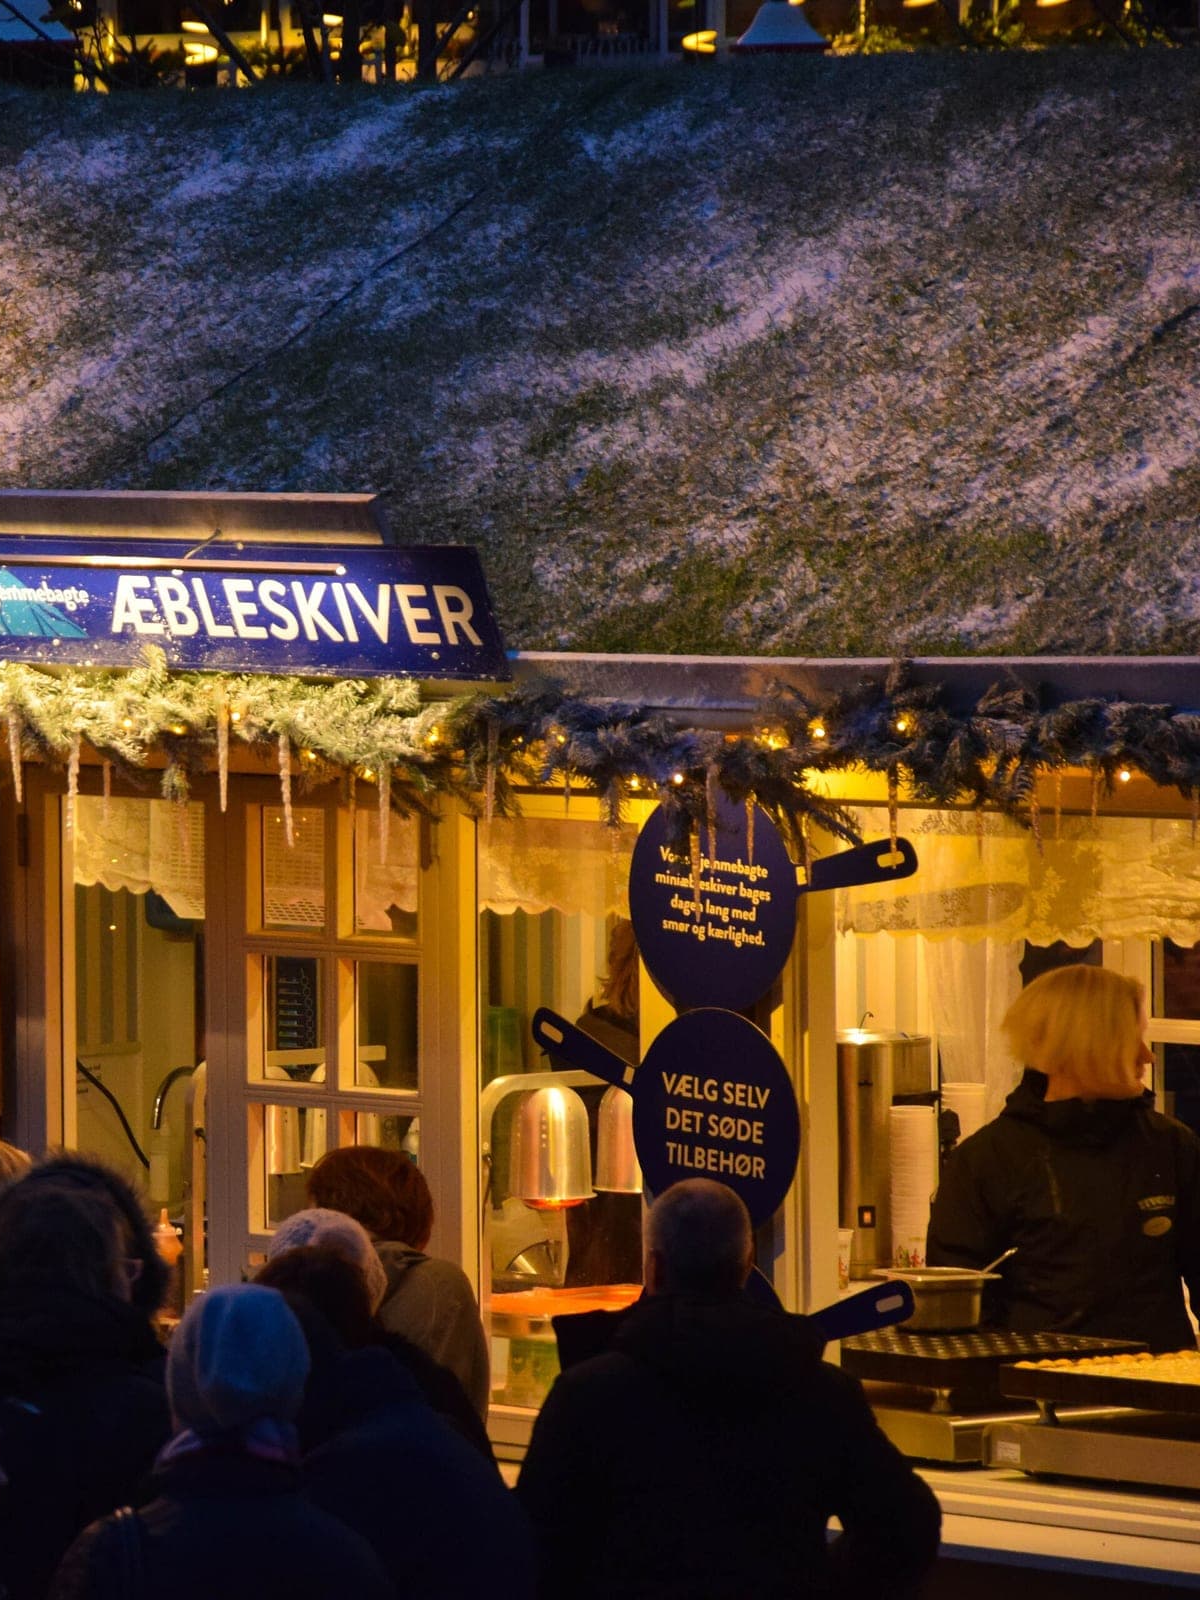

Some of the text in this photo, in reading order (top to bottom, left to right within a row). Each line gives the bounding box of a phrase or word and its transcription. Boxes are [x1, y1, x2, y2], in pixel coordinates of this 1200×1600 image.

[111, 574, 483, 646] ÆBLESKIVER
[700, 853, 769, 882] jemmebagte
[655, 870, 772, 905] miniæbeskiver bages
[706, 898, 730, 922] lang
[731, 906, 757, 922] med
[662, 919, 766, 948] smør og kærlighed.
[662, 1071, 772, 1110] VÆLG SELV
[665, 1107, 764, 1145] DET SØDE
[666, 1141, 767, 1180] TILBEHØR
